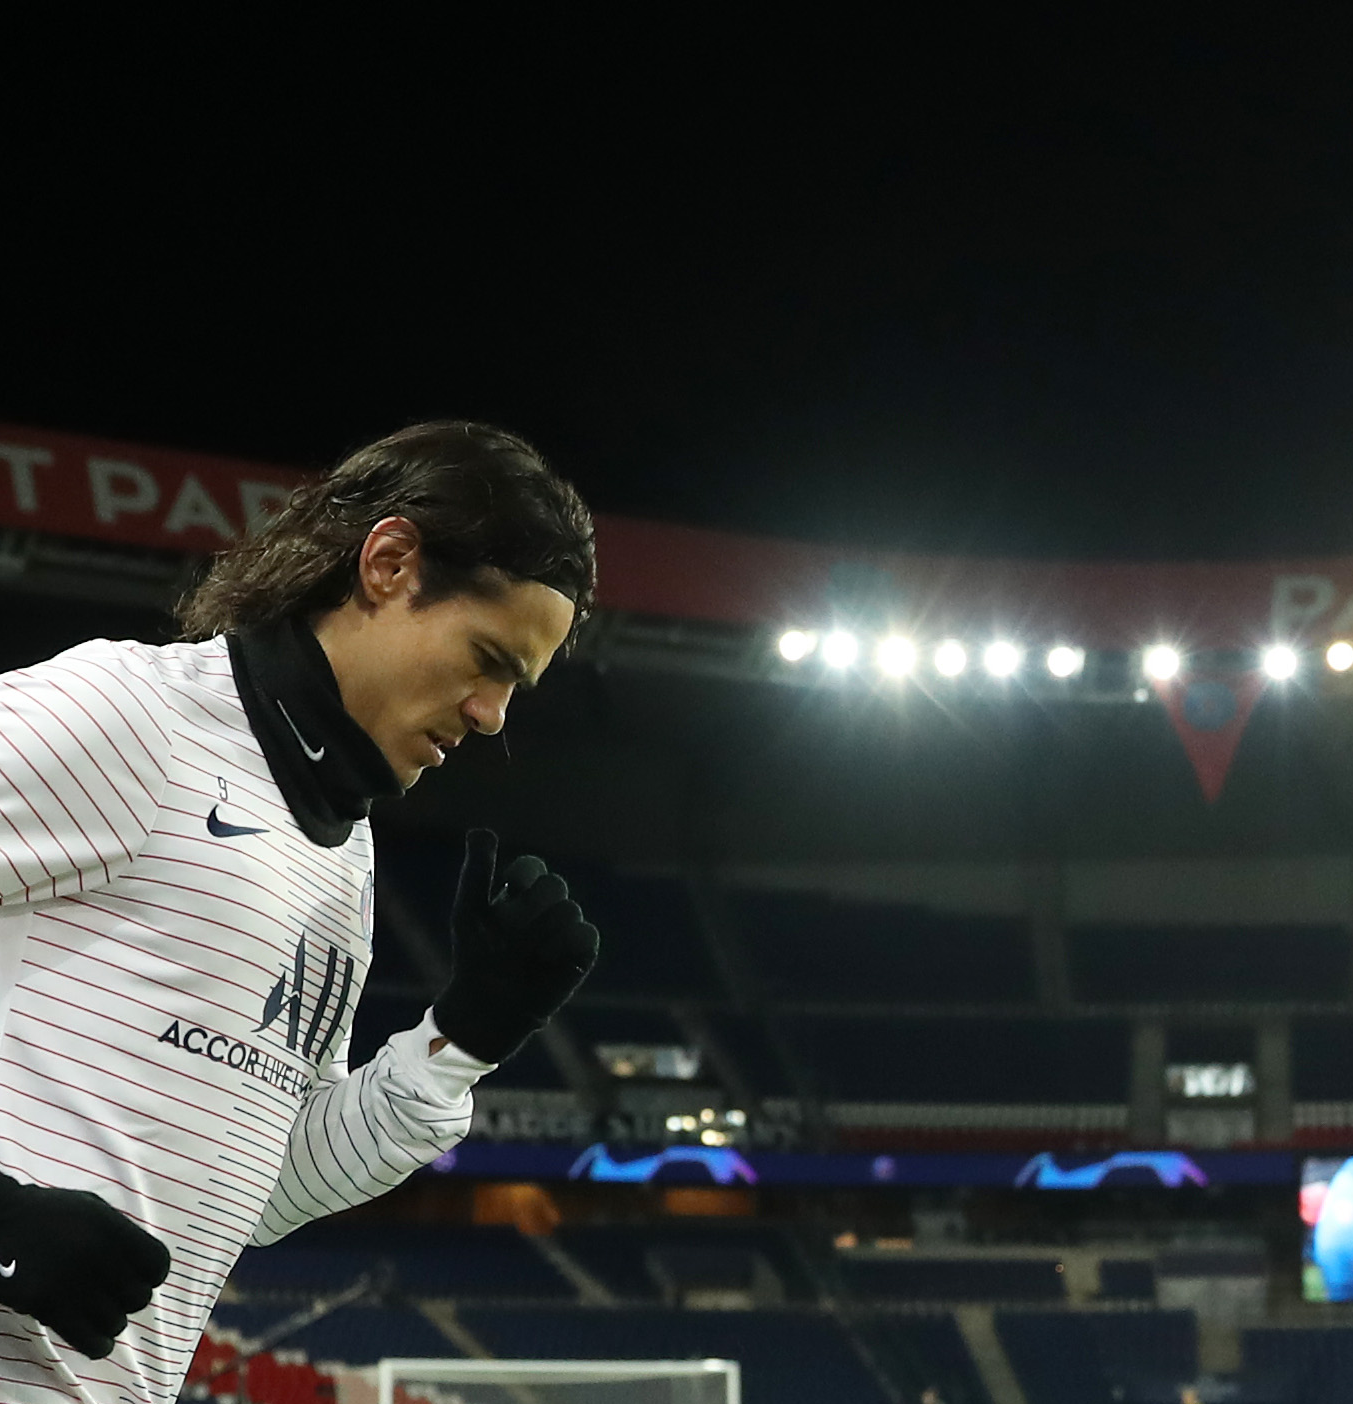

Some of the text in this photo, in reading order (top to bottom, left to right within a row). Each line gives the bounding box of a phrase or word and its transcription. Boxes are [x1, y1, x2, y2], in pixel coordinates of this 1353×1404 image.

[85, 457, 307, 541] PAR
[217, 776, 228, 801] 9
[157, 1019, 260, 1076] ACCOR
